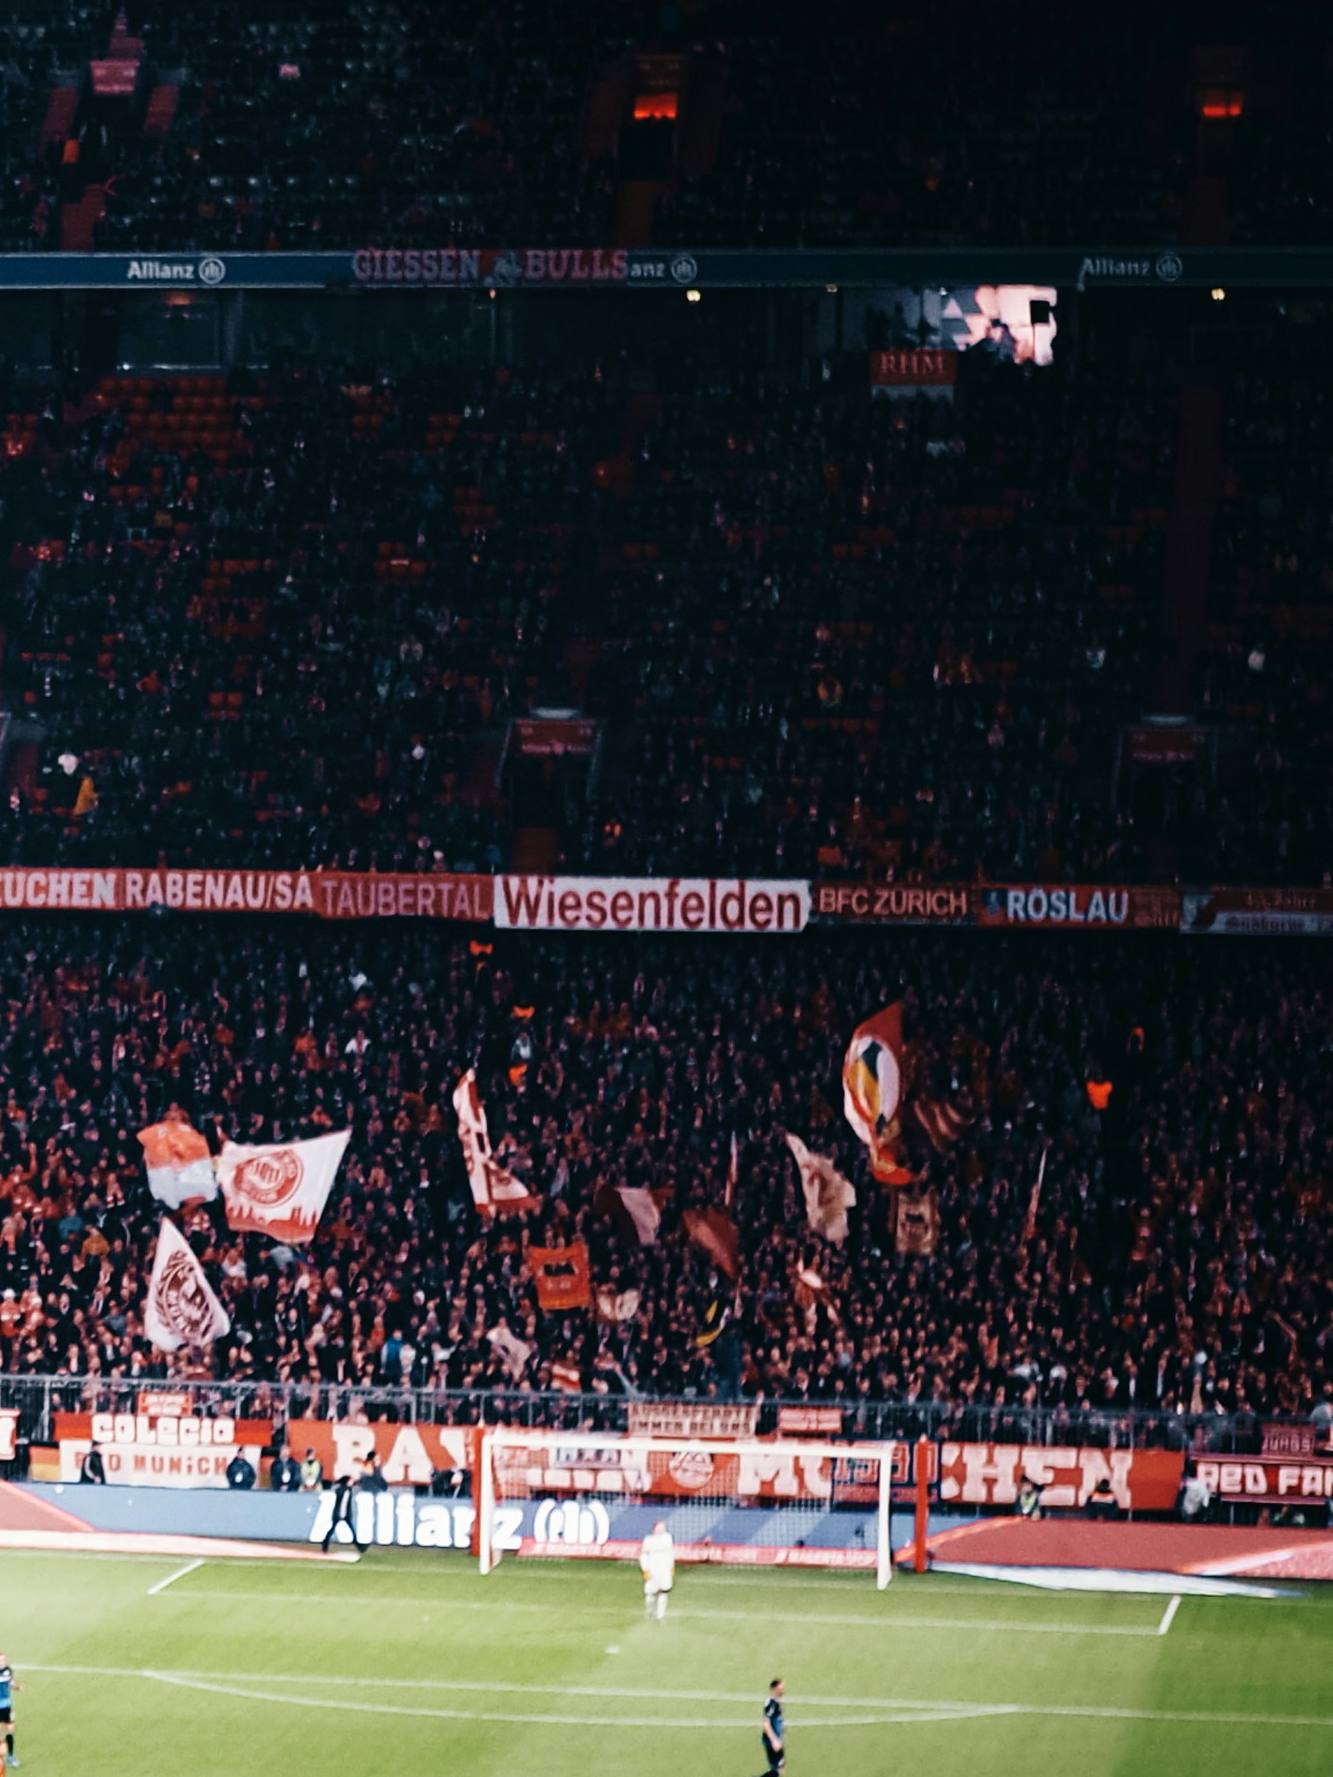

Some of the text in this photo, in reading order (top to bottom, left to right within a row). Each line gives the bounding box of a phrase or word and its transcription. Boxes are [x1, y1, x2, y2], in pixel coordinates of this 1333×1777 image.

[128, 259, 196, 280] Allianz
[351, 249, 481, 281] GIESSEN
[522, 249, 630, 280] BULLS
[1082, 256, 1151, 277] Allianz
[125, 872, 315, 911] RABENAU/SA
[321, 878, 491, 920] TAUBERTAL
[501, 876, 803, 930] Wiesenfelden
[819, 888, 870, 914] BFC
[1196, 1462, 1268, 1495] RED
[309, 1488, 523, 1550] Allianz
